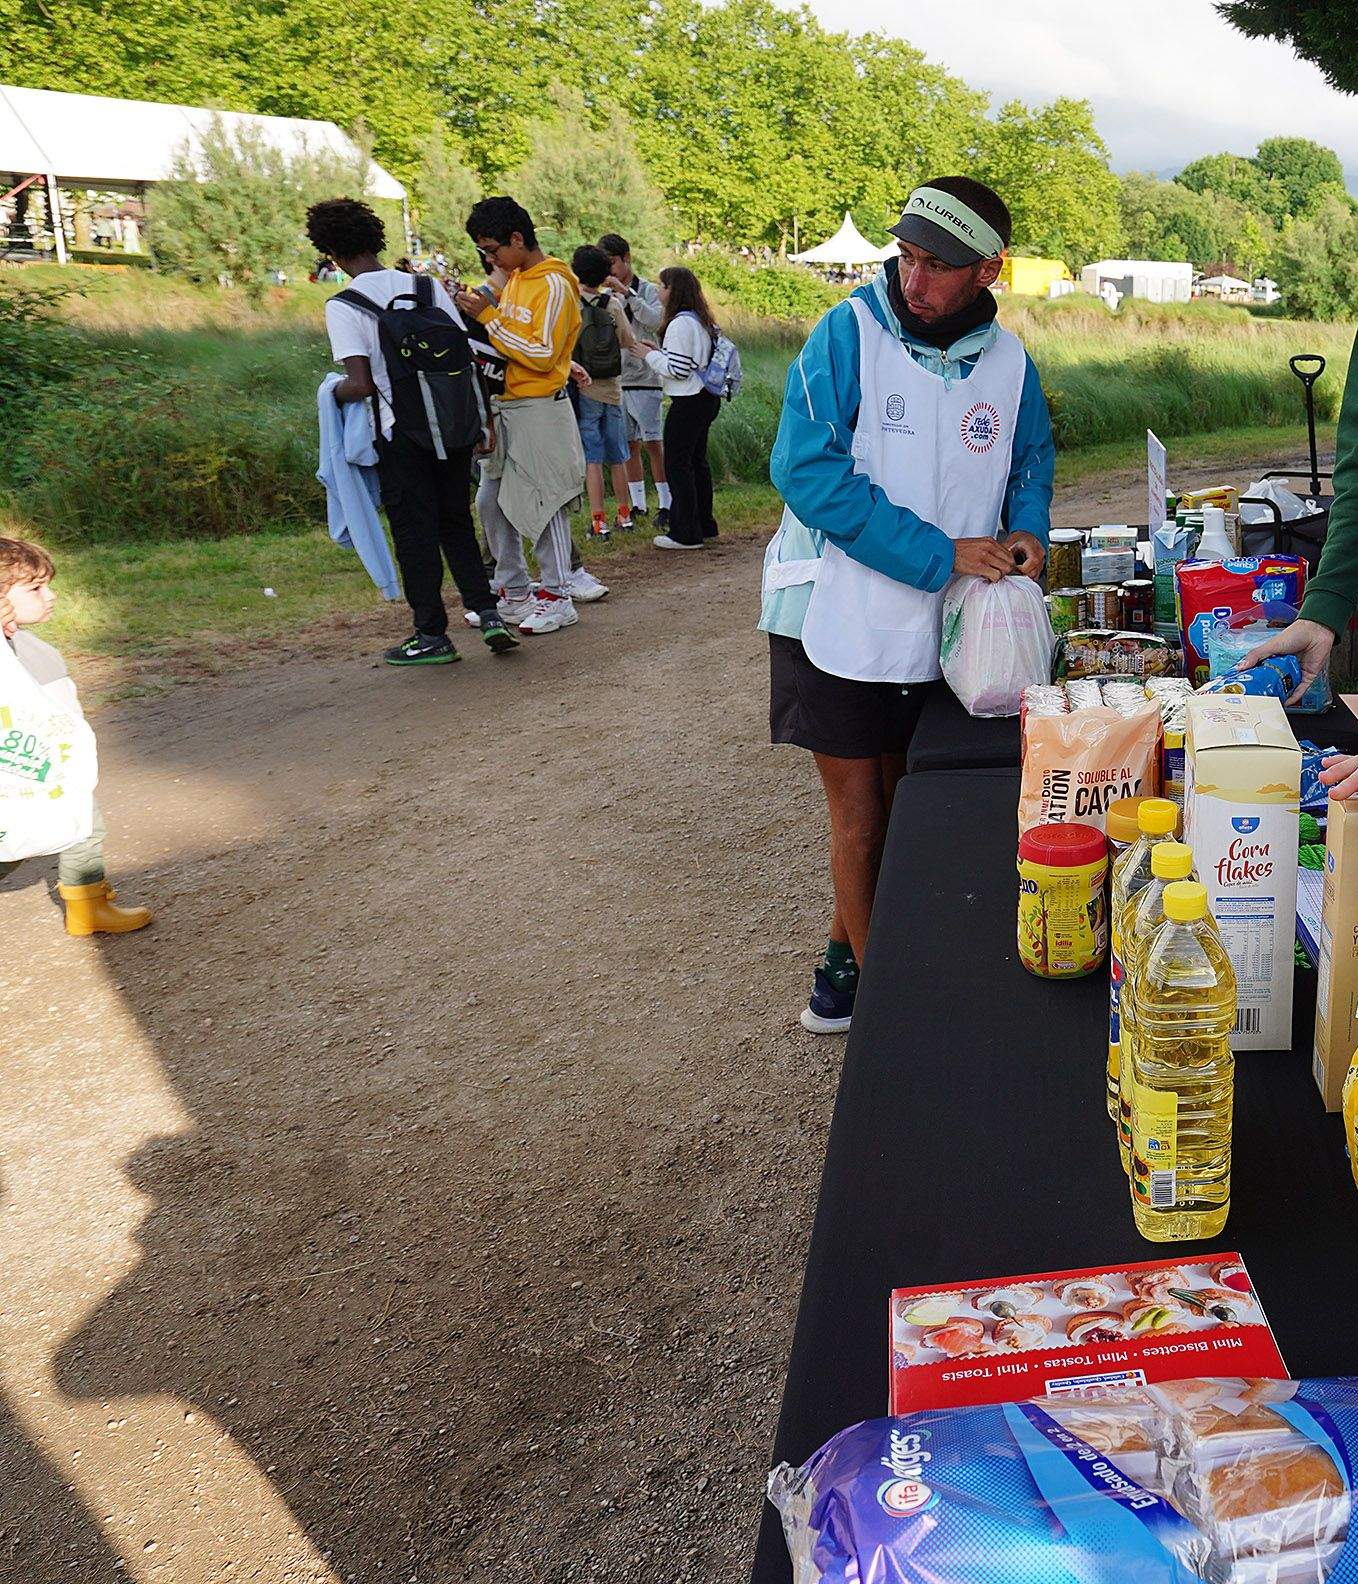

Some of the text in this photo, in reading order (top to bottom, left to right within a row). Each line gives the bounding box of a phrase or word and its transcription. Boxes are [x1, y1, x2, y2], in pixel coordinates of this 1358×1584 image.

[926, 201, 976, 239] LURBEL
[968, 426, 992, 434] AXUDA
[1077, 768, 1132, 784] SOLUBLE AL
[1048, 770, 1072, 824] ATION
[1229, 838, 1270, 860] Corn
[1214, 858, 1273, 886] flakes
[1352, 935, 1358, 945] Y
[942, 1337, 1243, 1381] Mini Biscottes Mini Tostas Mini Toasts
[1078, 1449, 1097, 1462] de
[898, 1482, 918, 1504] ifa
